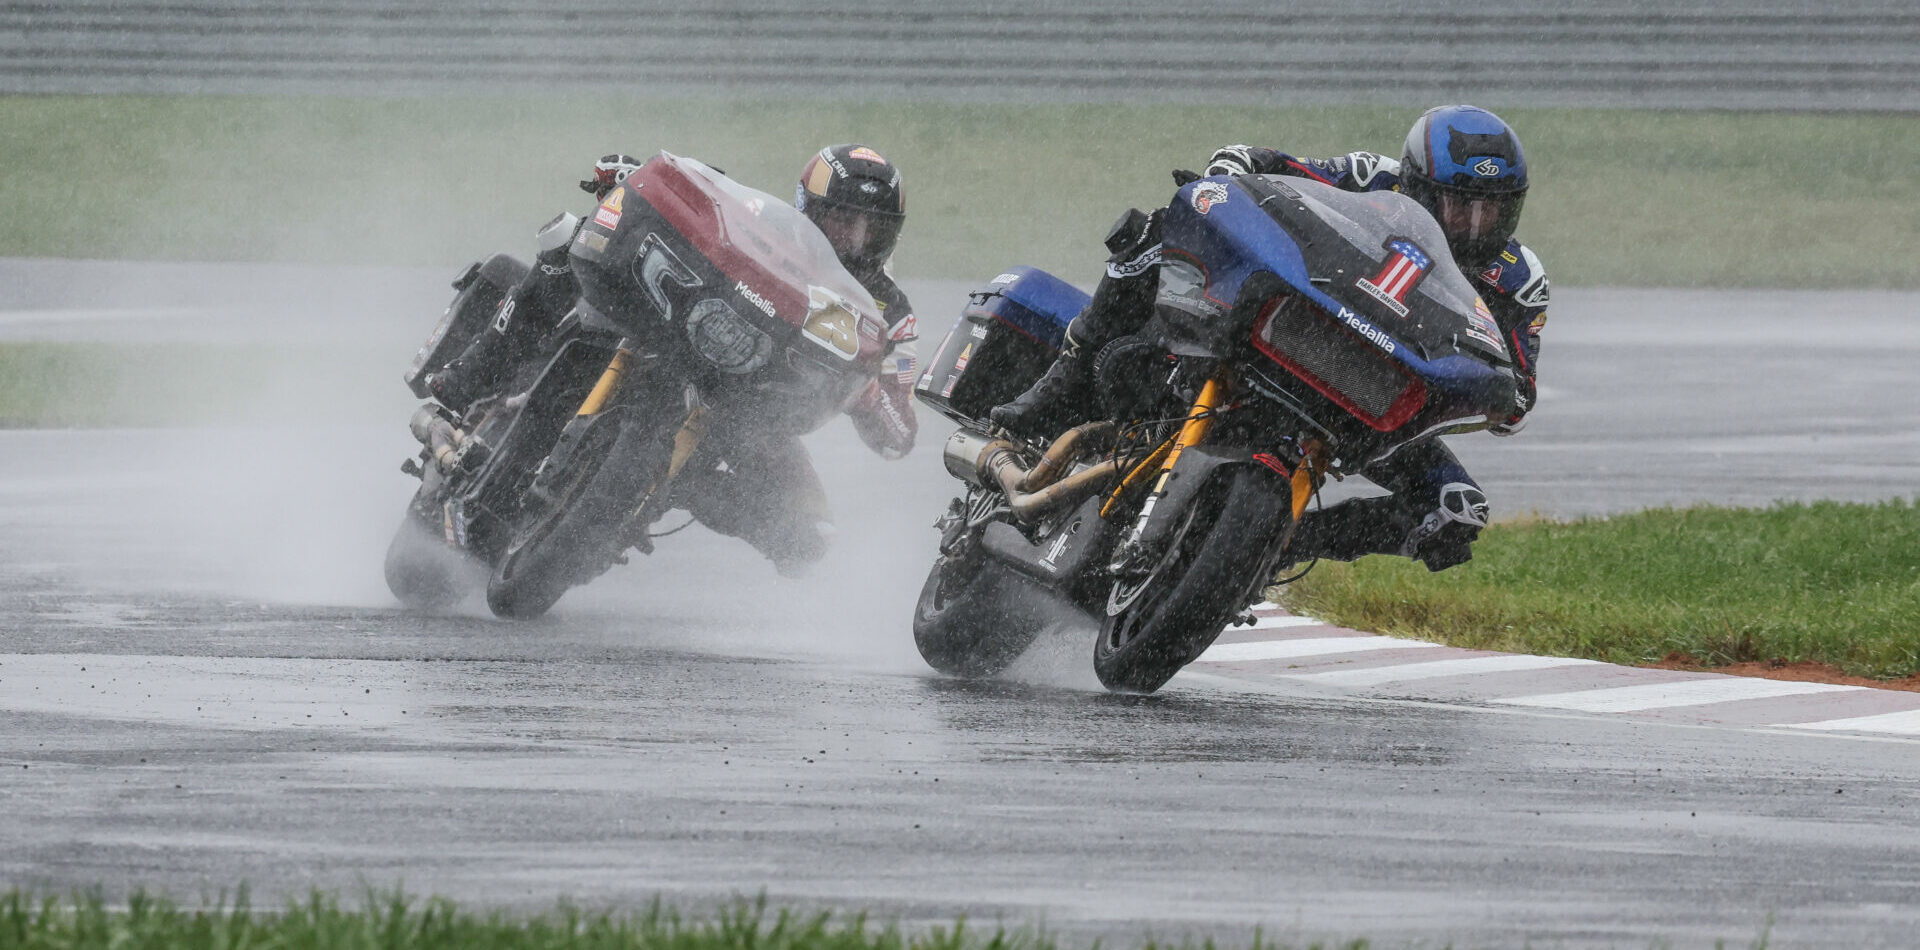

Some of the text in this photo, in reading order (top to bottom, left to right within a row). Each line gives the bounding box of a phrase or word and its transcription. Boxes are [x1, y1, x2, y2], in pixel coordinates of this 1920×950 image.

[735, 280, 776, 318] Medallia
[1358, 279, 1408, 316] HARLEY-DAVIDSON
[1337, 307, 1396, 354] Medallia
